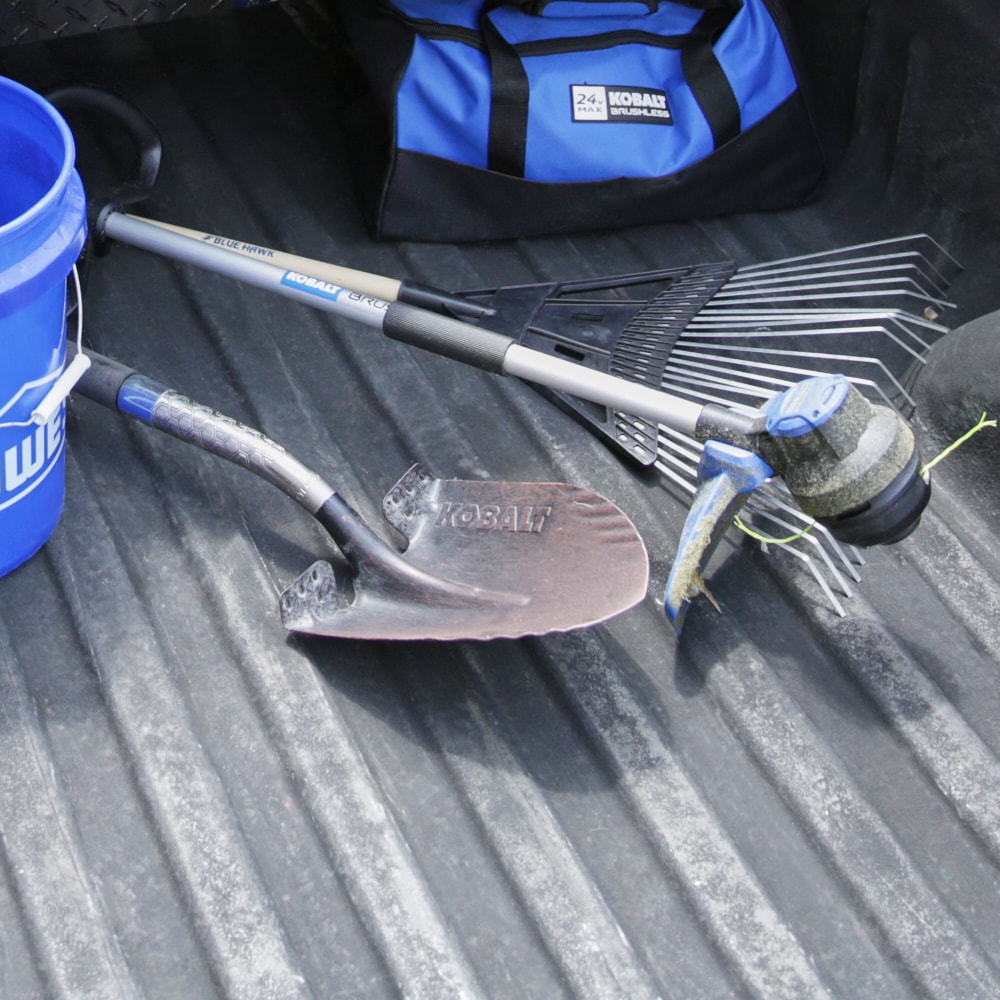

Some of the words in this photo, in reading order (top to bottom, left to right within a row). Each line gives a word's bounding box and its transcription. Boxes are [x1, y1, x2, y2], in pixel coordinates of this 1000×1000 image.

[608, 91, 666, 109] KOBALT
[610, 107, 670, 118] BRUSHLESS
[214, 237, 240, 250] BLUE
[241, 244, 275, 258] HAWK
[286, 269, 343, 295] KOBALT
[435, 501, 552, 534] KOBALT
